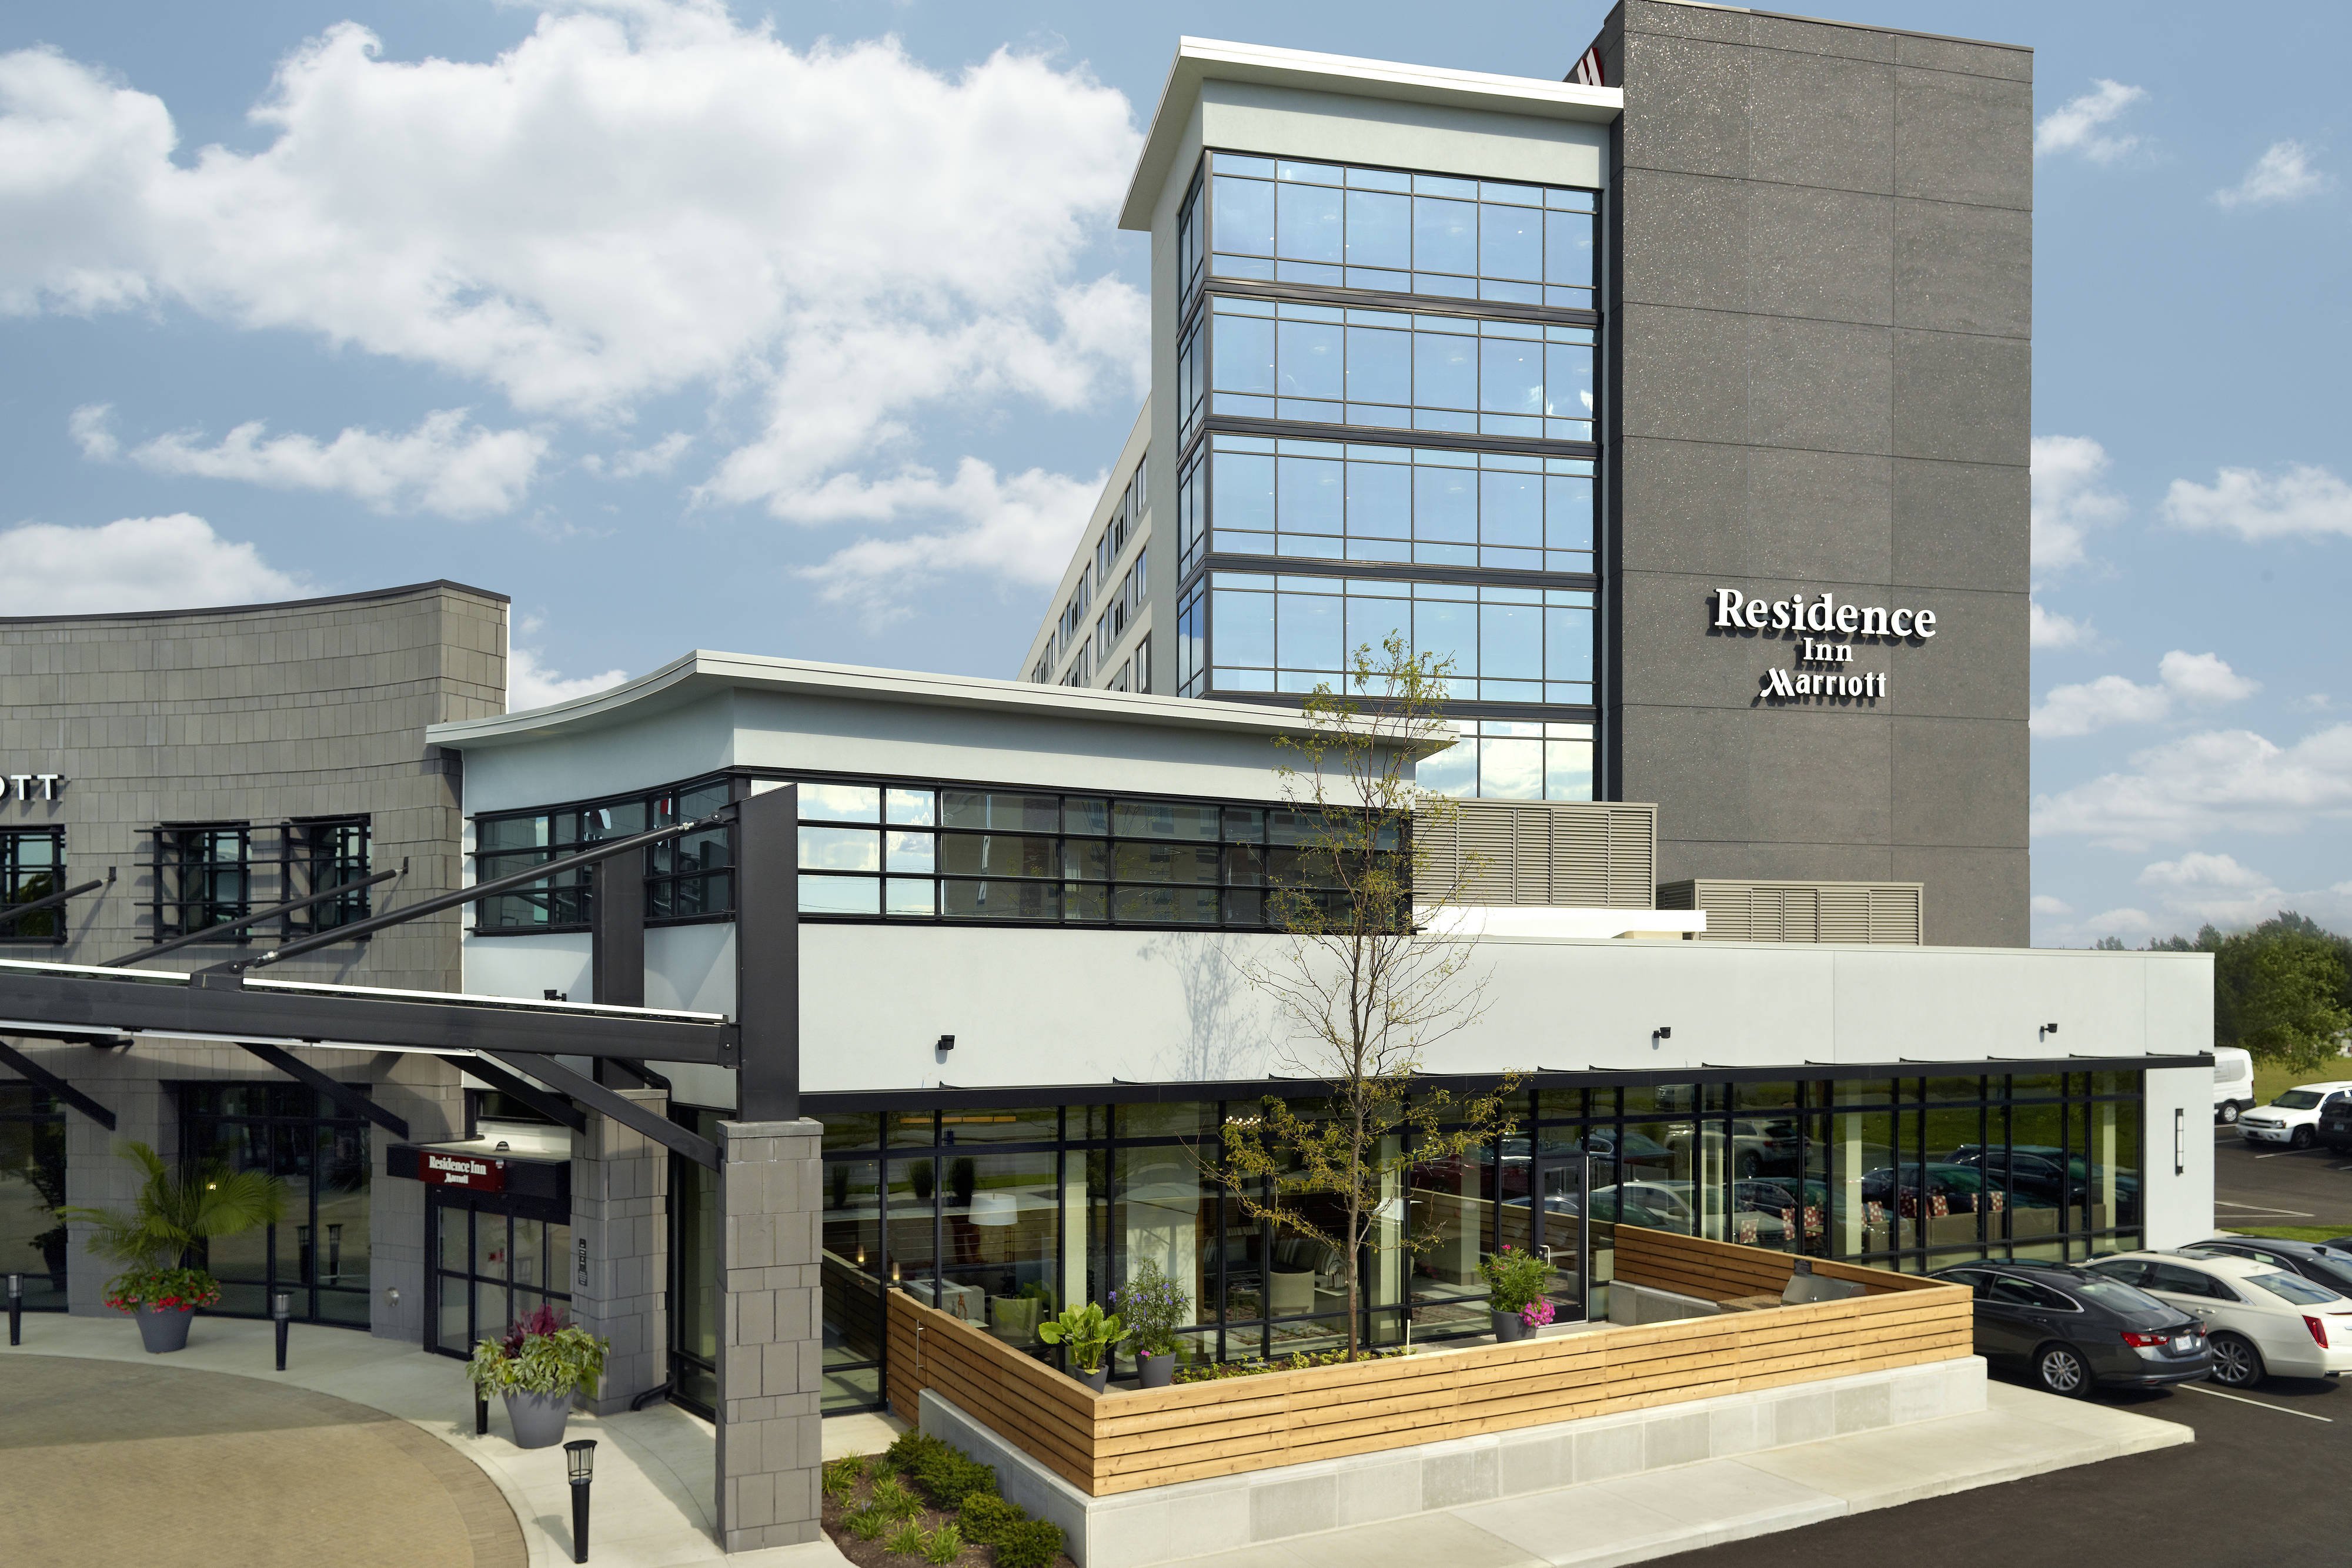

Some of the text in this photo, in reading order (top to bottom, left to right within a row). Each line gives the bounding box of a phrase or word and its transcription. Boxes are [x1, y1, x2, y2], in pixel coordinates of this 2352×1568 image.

[1714, 587, 1937, 638] Residence
[1803, 637, 1854, 663] Inn
[1759, 667, 1887, 697] Marriott
[0, 774, 59, 801] TT
[429, 1155, 487, 1175] Residence Inn
